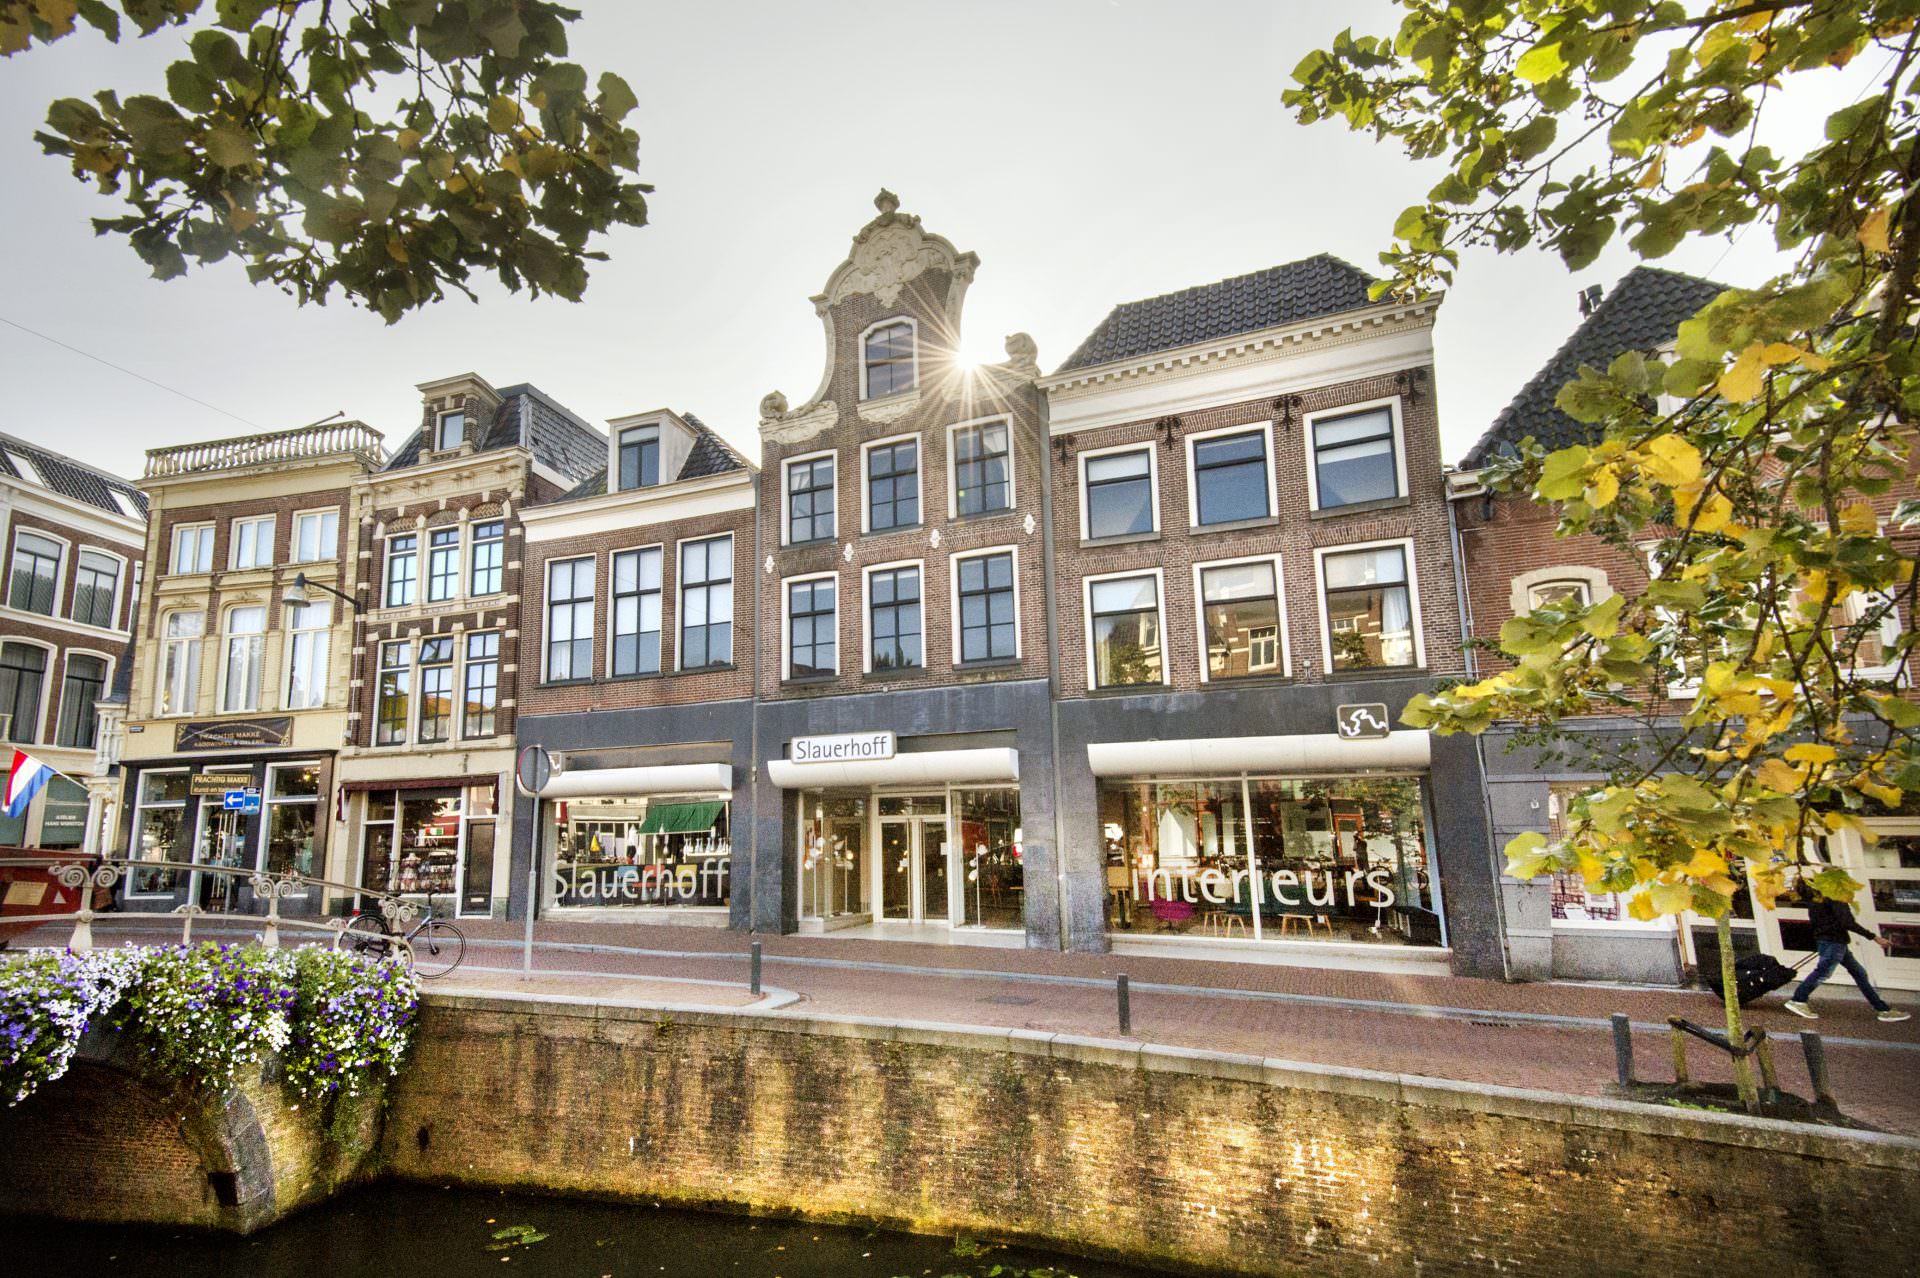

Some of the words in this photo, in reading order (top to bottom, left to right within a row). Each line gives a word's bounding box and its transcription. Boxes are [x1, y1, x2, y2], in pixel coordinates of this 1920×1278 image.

[796, 736, 887, 759] Slauerhoff
[551, 858, 731, 900] Slauerhoff
[1132, 858, 1396, 908] interieurs
